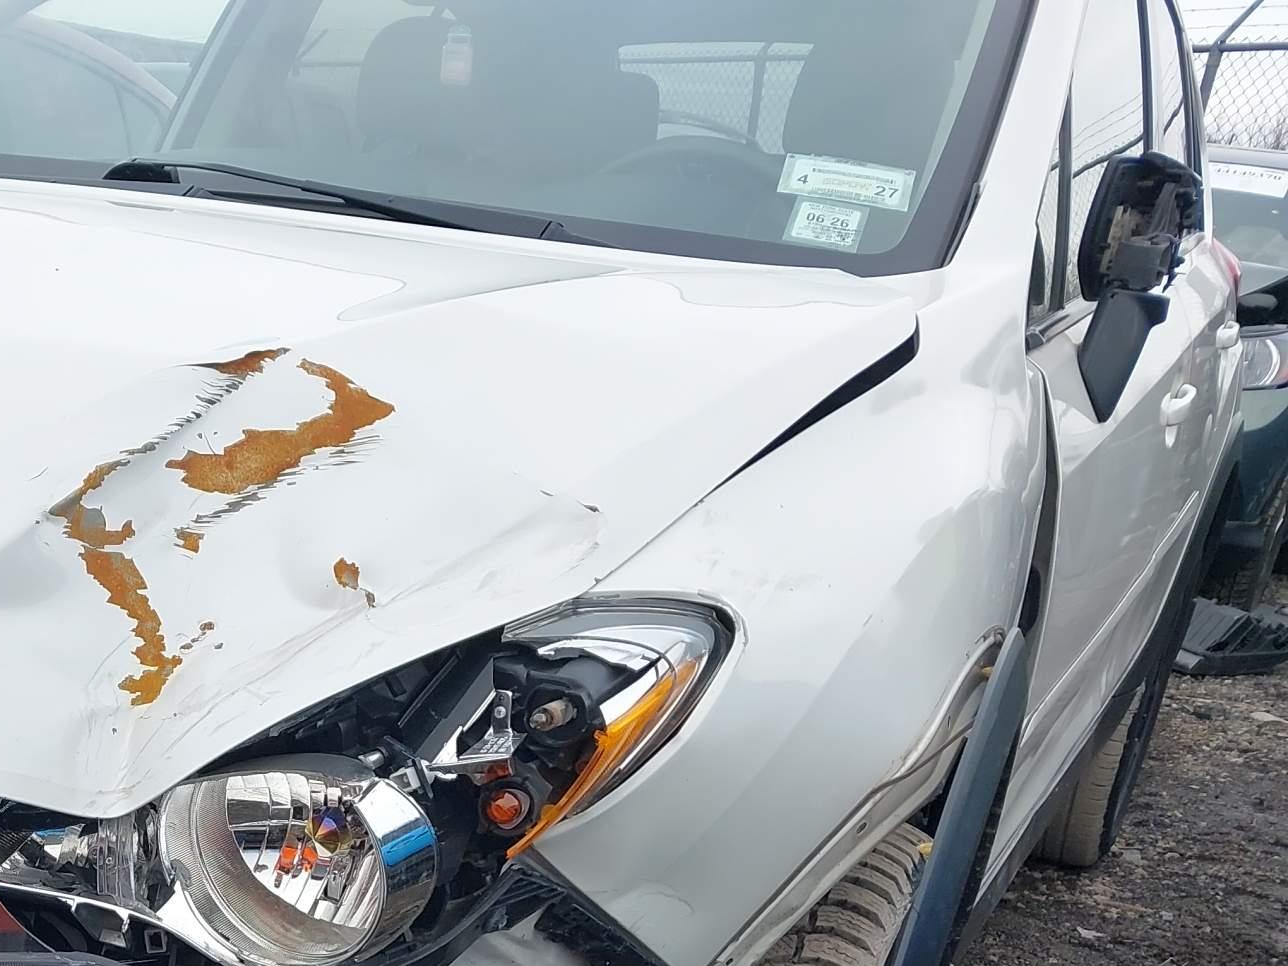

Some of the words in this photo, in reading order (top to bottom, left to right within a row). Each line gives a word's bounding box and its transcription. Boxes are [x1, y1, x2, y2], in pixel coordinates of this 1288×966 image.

[797, 174, 809, 185] 4
[874, 185, 899, 199] 27
[806, 212, 825, 224] 06
[830, 216, 850, 229] 26
